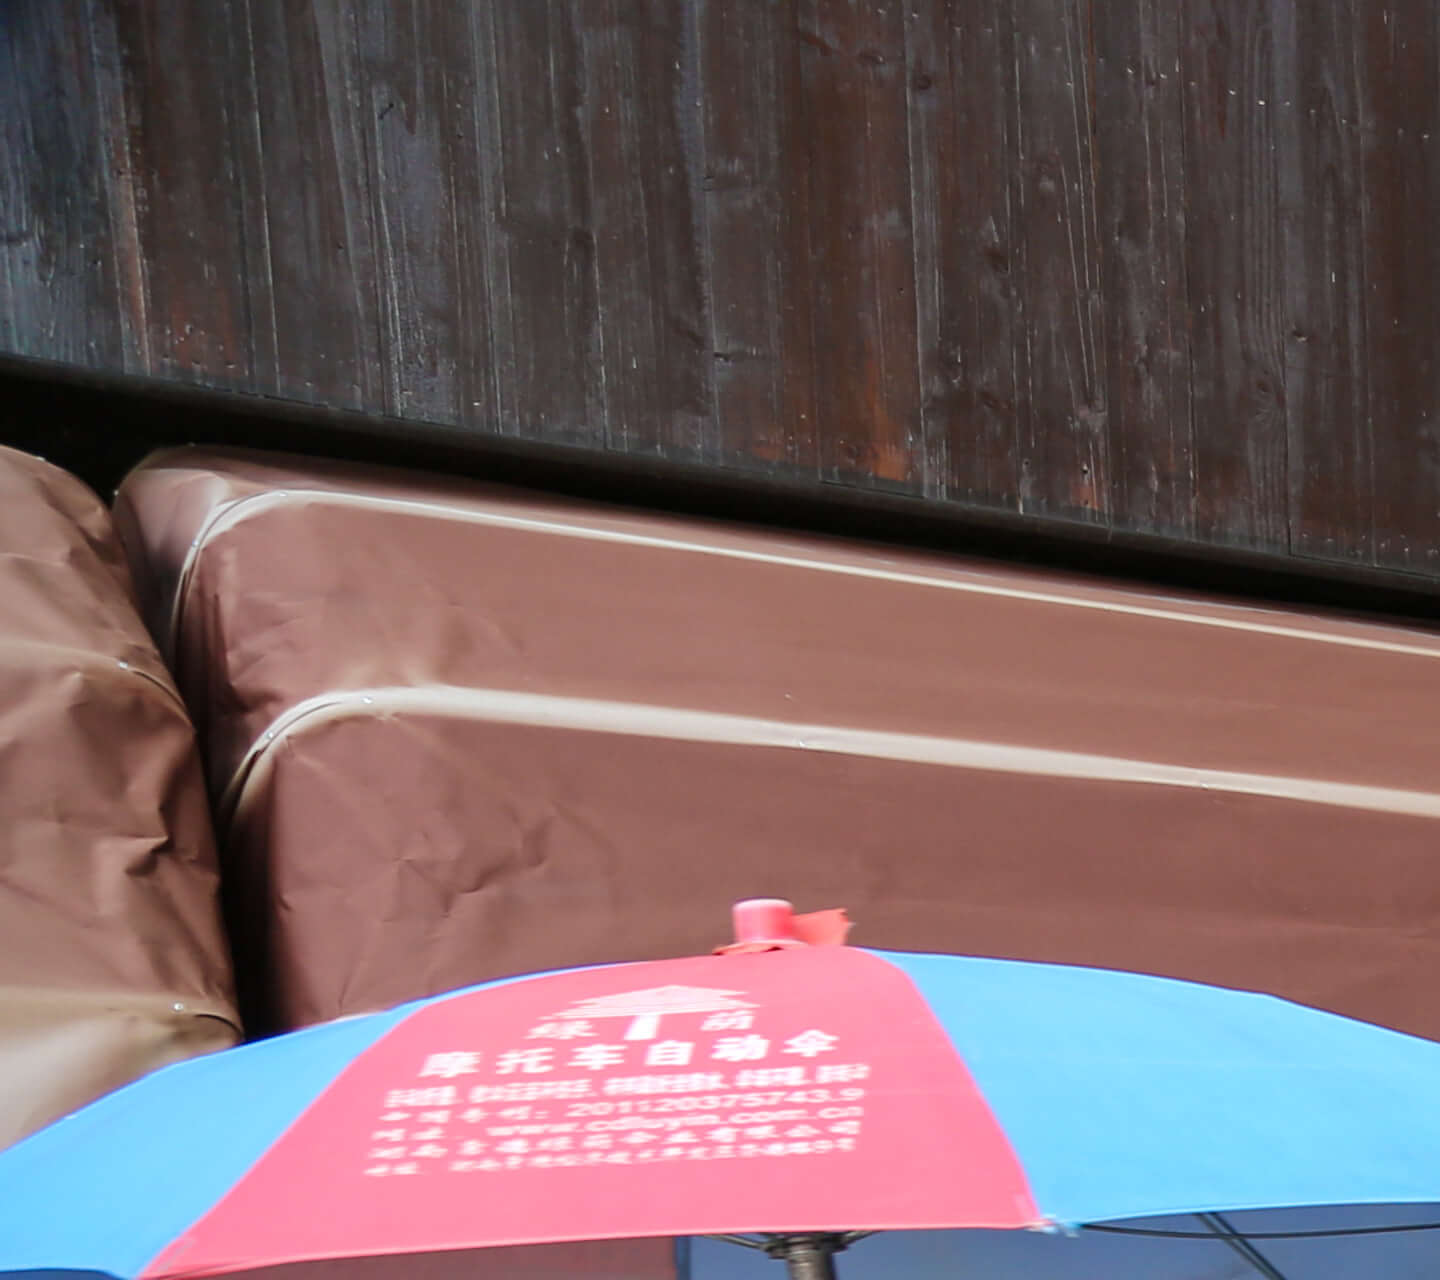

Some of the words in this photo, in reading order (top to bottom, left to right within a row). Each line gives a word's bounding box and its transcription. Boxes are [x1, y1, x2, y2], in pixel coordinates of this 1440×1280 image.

[417, 1028, 840, 1079] 摩托车自动伞
